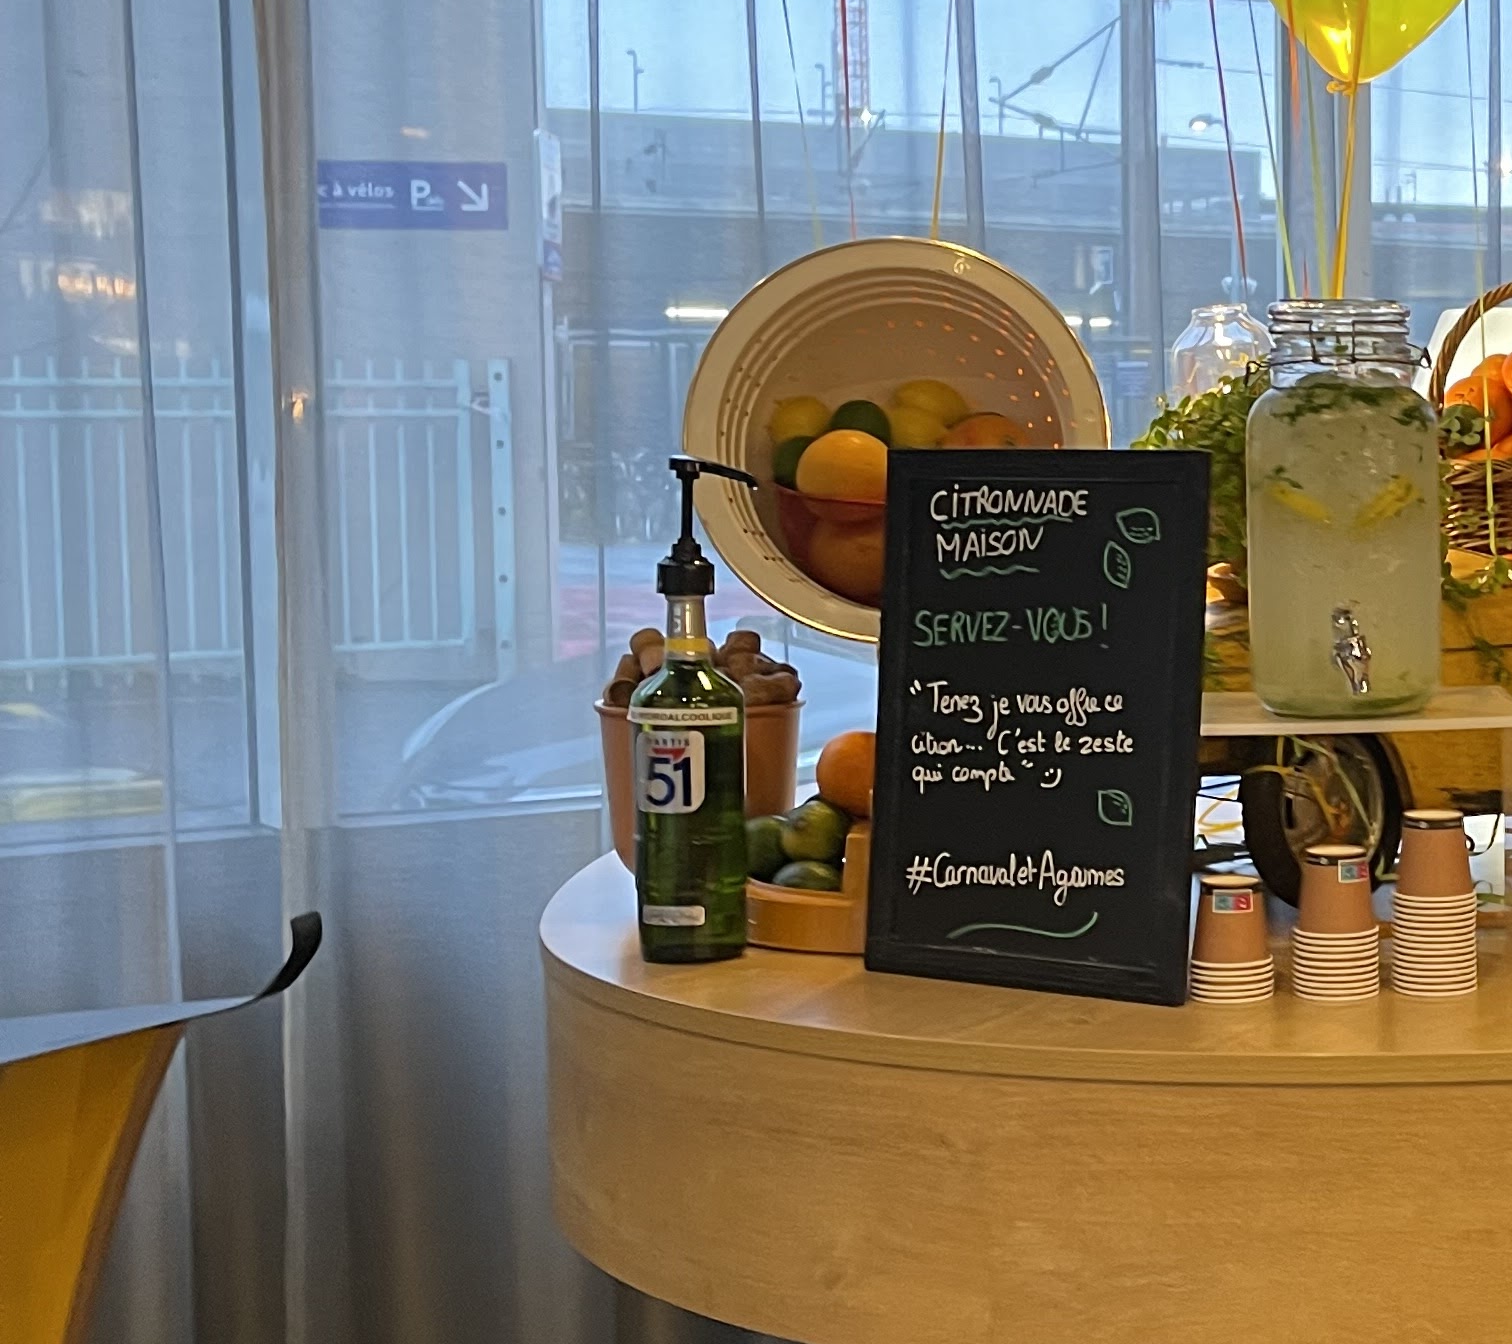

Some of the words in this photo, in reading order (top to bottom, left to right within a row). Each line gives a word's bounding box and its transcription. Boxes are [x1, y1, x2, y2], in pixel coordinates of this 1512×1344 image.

[347, 182, 395, 198] vélos
[986, 694, 1010, 740] je
[1016, 693, 1054, 715] vous
[1056, 687, 1102, 727] offre
[1104, 693, 1124, 711] ce
[997, 727, 1047, 755] C'est
[1054, 730, 1071, 753] le
[1078, 729, 1135, 756] zeste
[645, 756, 692, 808] 51
[911, 763, 944, 795] qui
